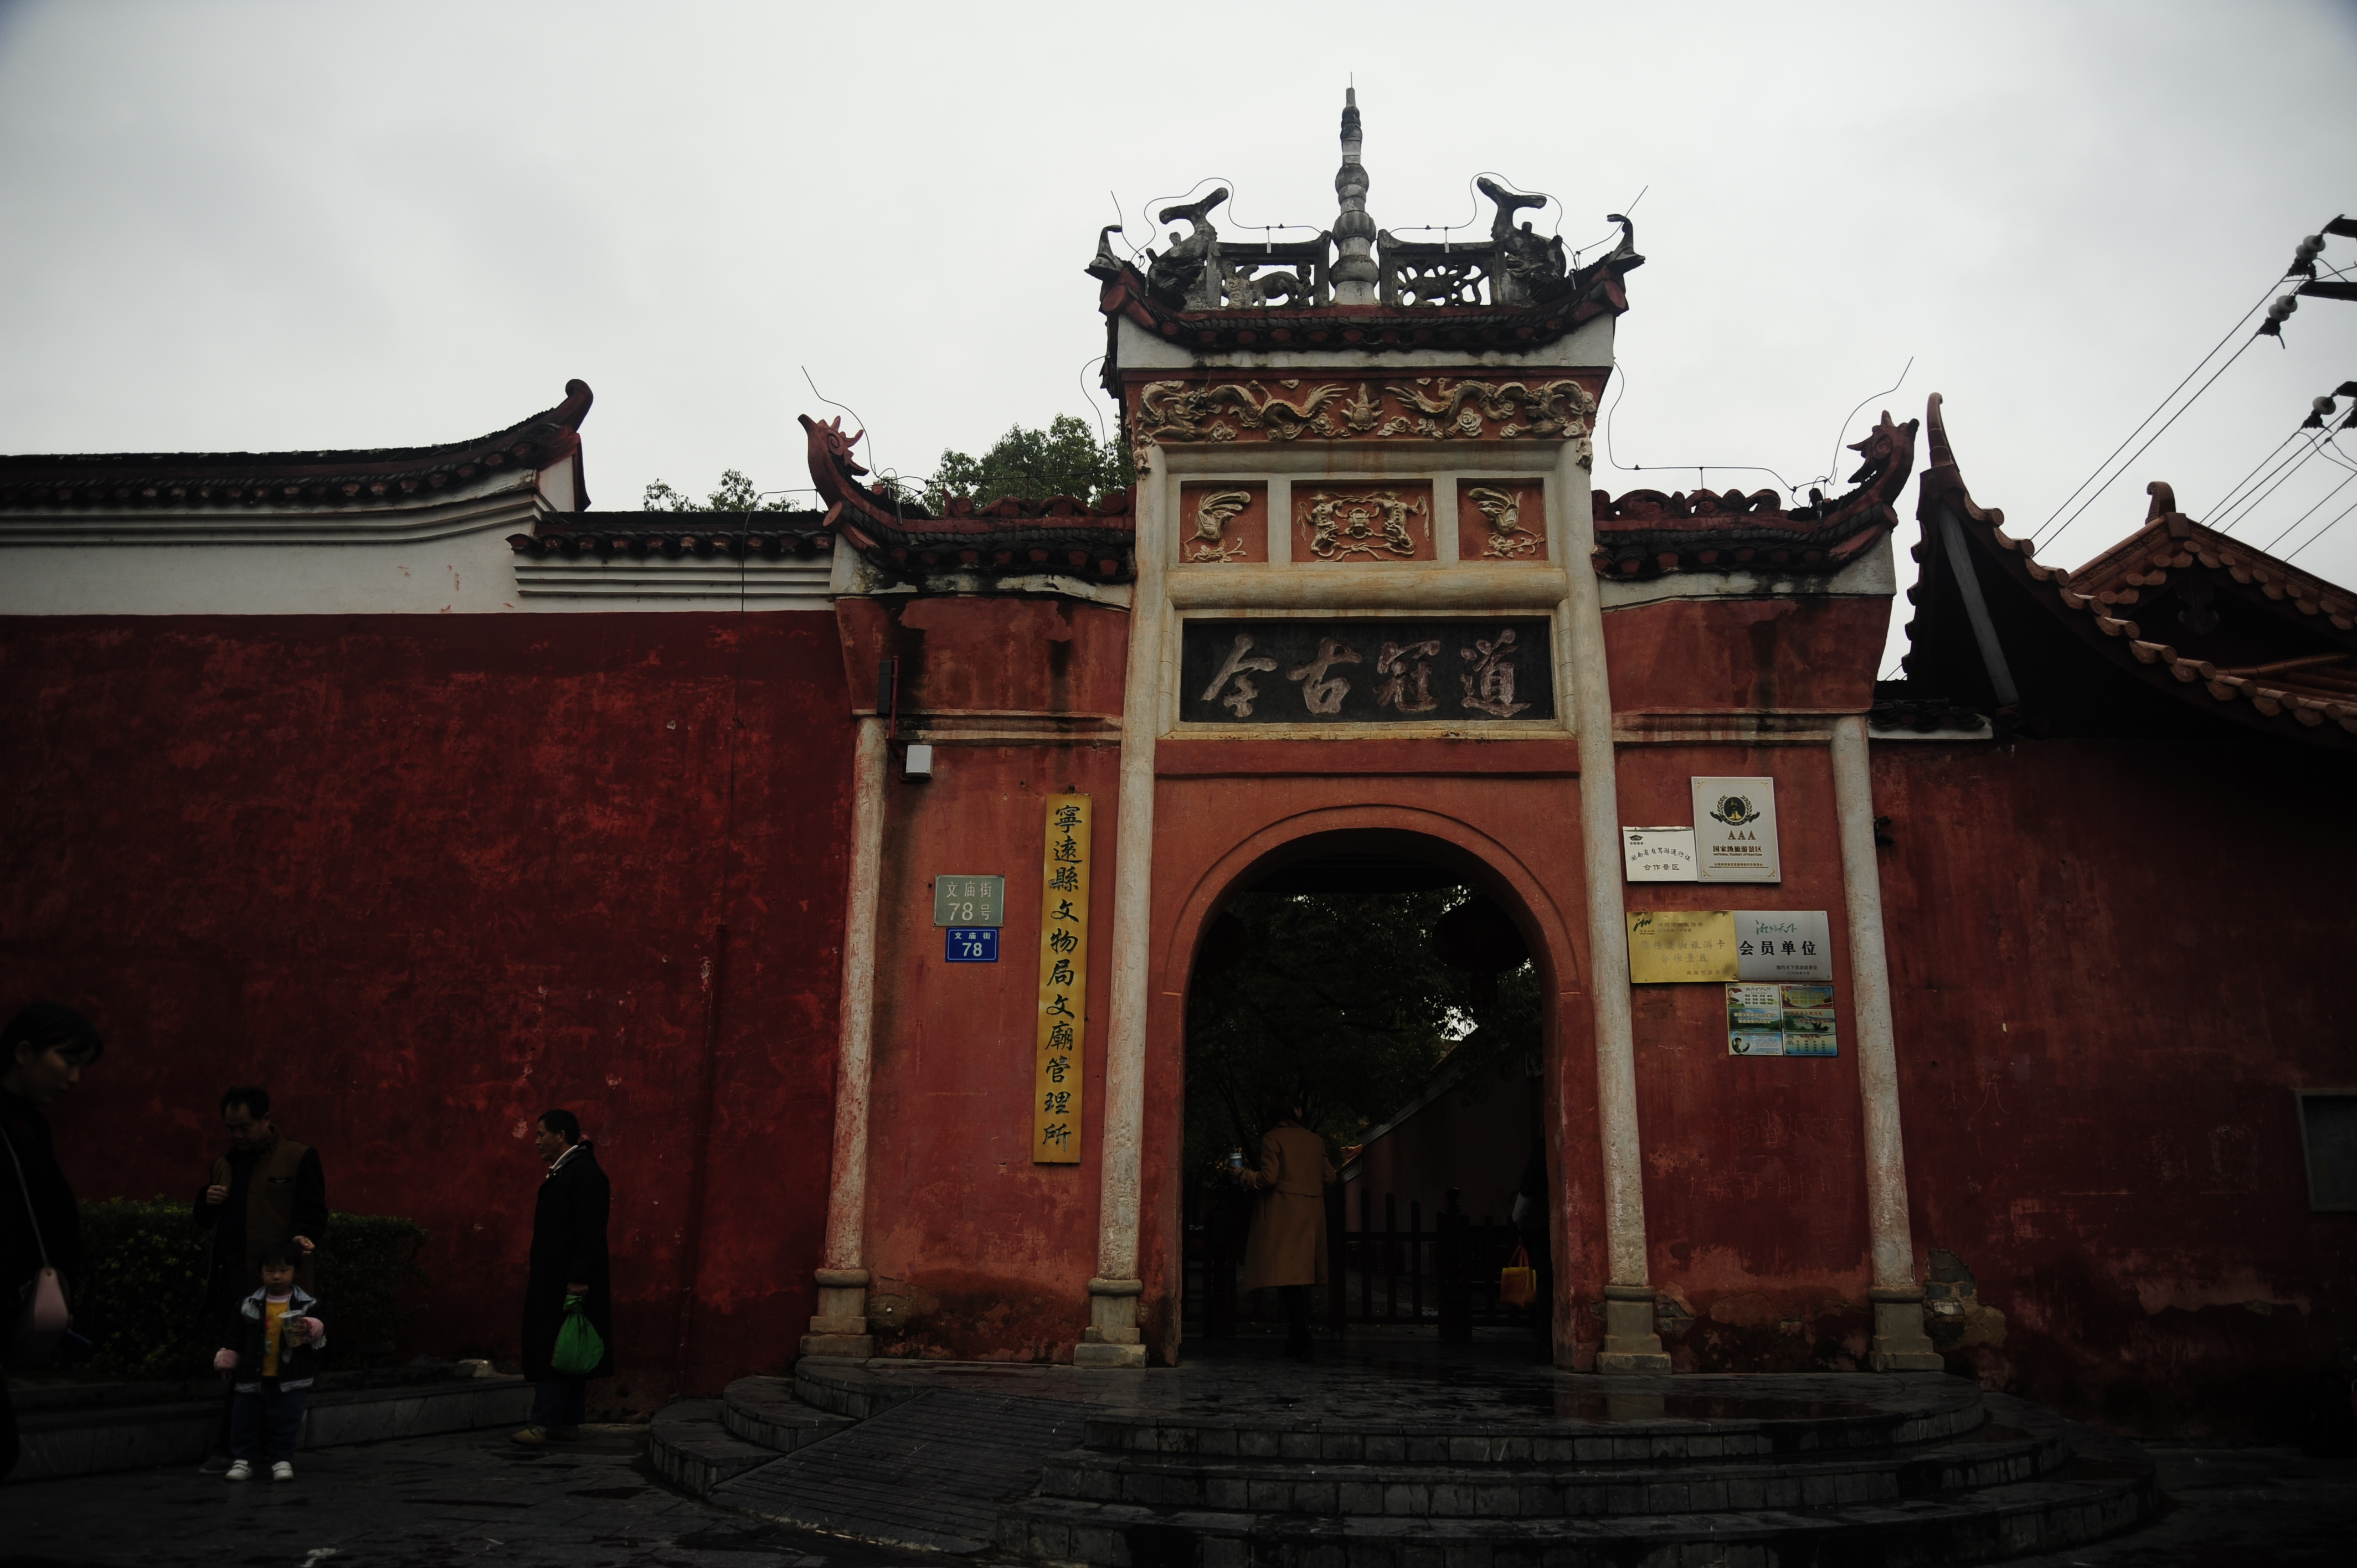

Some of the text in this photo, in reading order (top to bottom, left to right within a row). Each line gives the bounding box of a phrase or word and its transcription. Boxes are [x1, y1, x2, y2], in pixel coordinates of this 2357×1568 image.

[1727, 830, 1756, 840] AAA
[946, 881, 992, 898] 文庙街
[954, 932, 991, 940] 文庙街
[962, 942, 982, 957] 78
[1739, 940, 1817, 956] 会员单位
[1042, 804, 1083, 1152] 寧遠縣文物局文廟管理所
